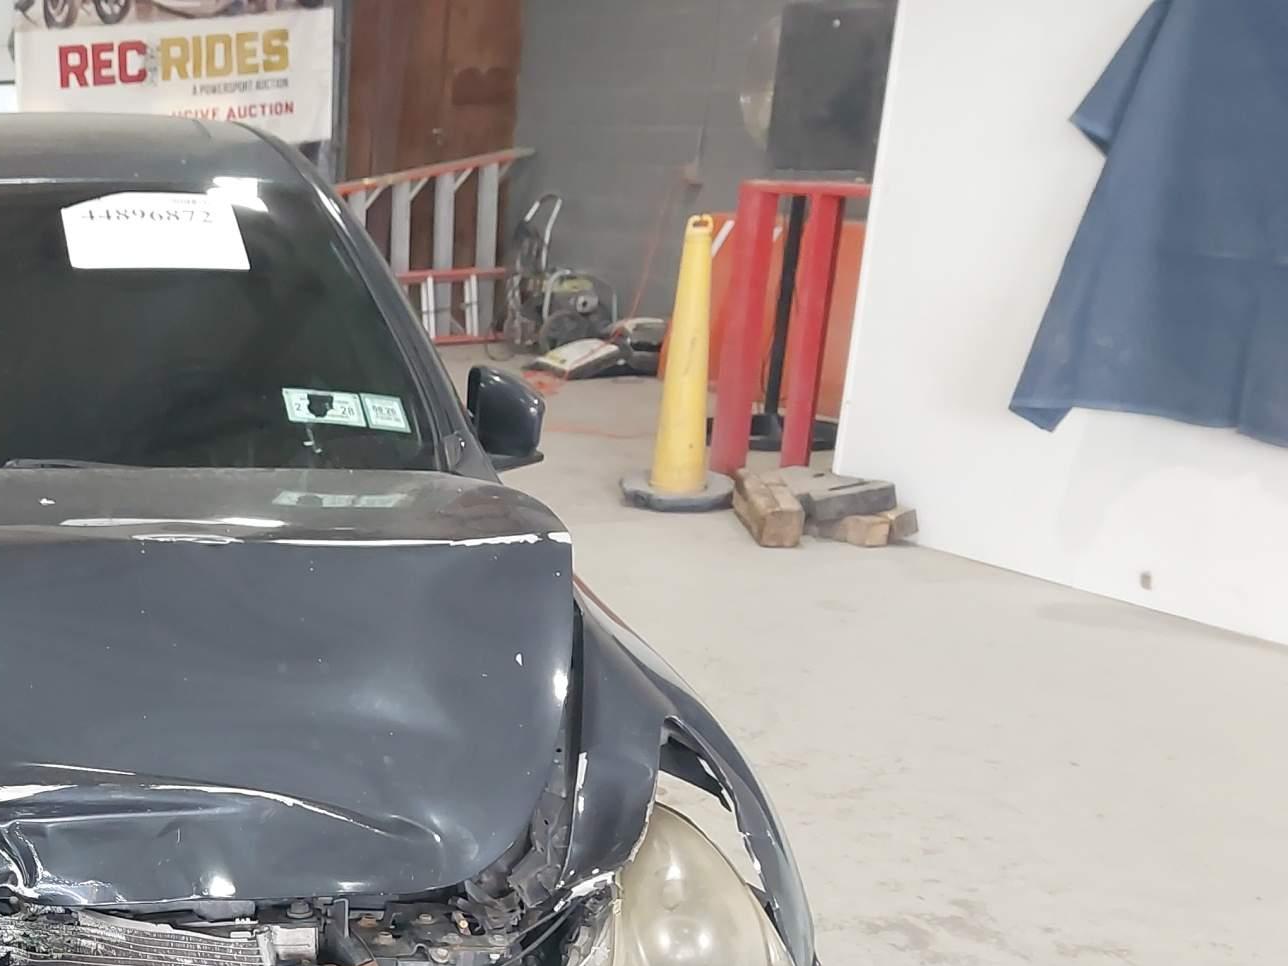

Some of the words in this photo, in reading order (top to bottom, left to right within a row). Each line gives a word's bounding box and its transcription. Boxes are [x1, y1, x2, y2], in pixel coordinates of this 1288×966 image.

[58, 40, 147, 88] REC
[160, 29, 289, 82] RIDES
[255, 78, 289, 91] AUCTION
[226, 101, 294, 120] AUCTION
[81, 209, 212, 223] 44896872
